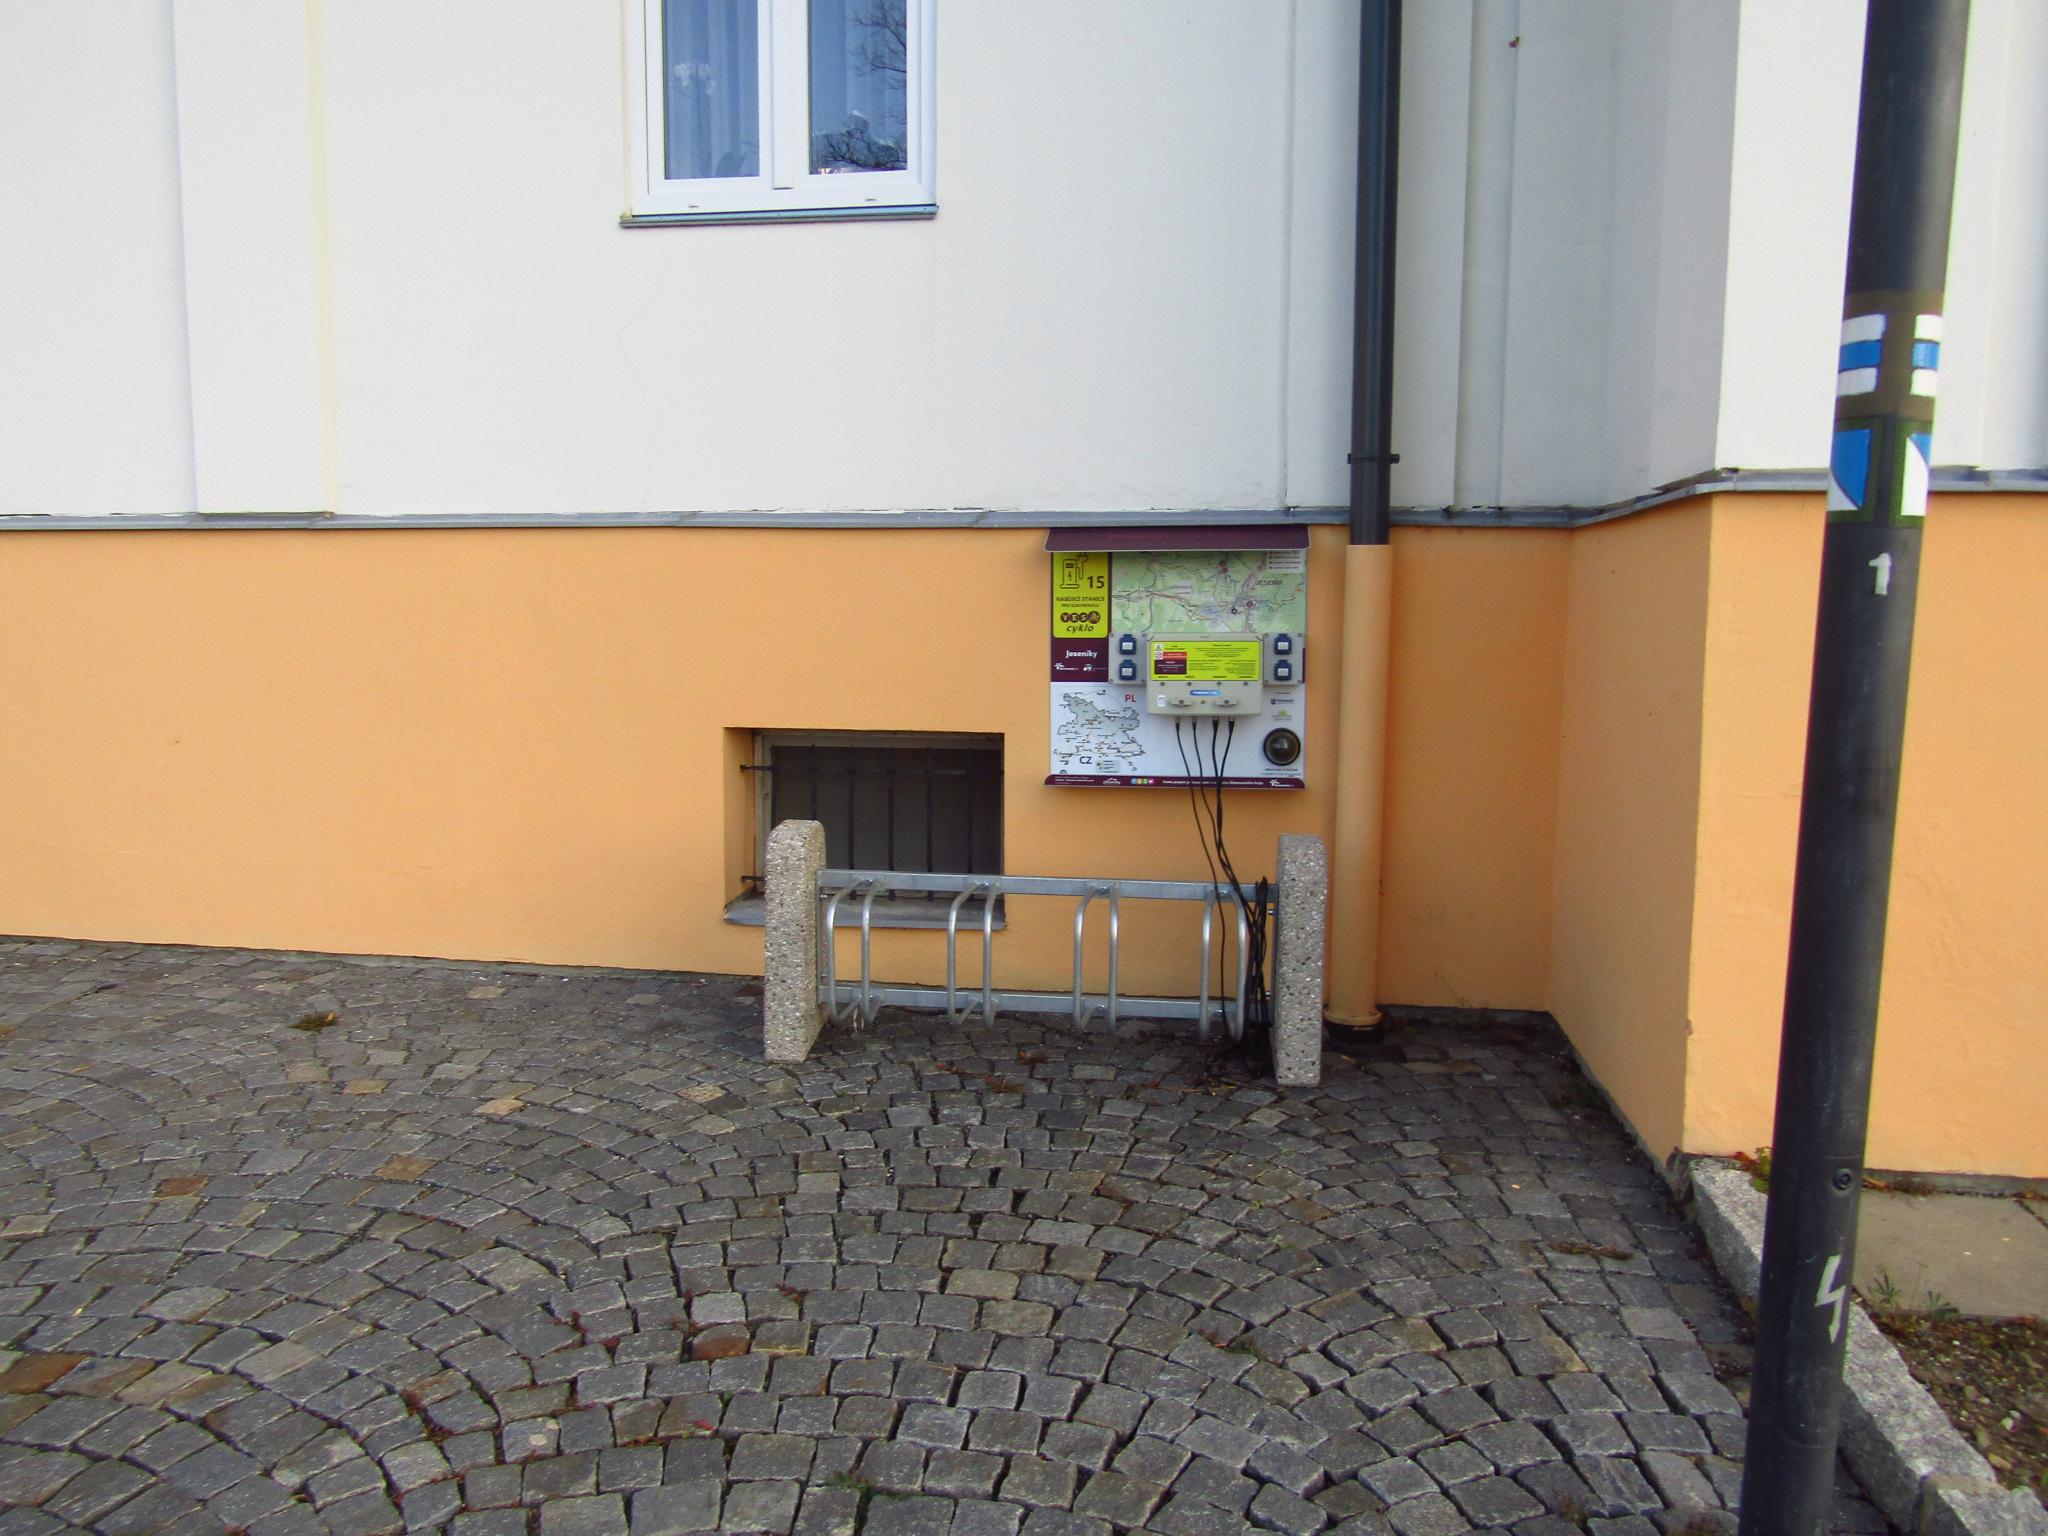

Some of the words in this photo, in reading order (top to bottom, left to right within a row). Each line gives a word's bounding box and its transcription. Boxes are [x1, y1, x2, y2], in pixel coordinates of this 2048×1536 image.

[1868, 552, 1892, 595] 1
[1087, 575, 1105, 589] 15
[1061, 613, 1087, 622] YES
[1066, 623, 1094, 634] cyklo
[1124, 694, 1137, 703] PL
[1079, 756, 1093, 765] CZ
